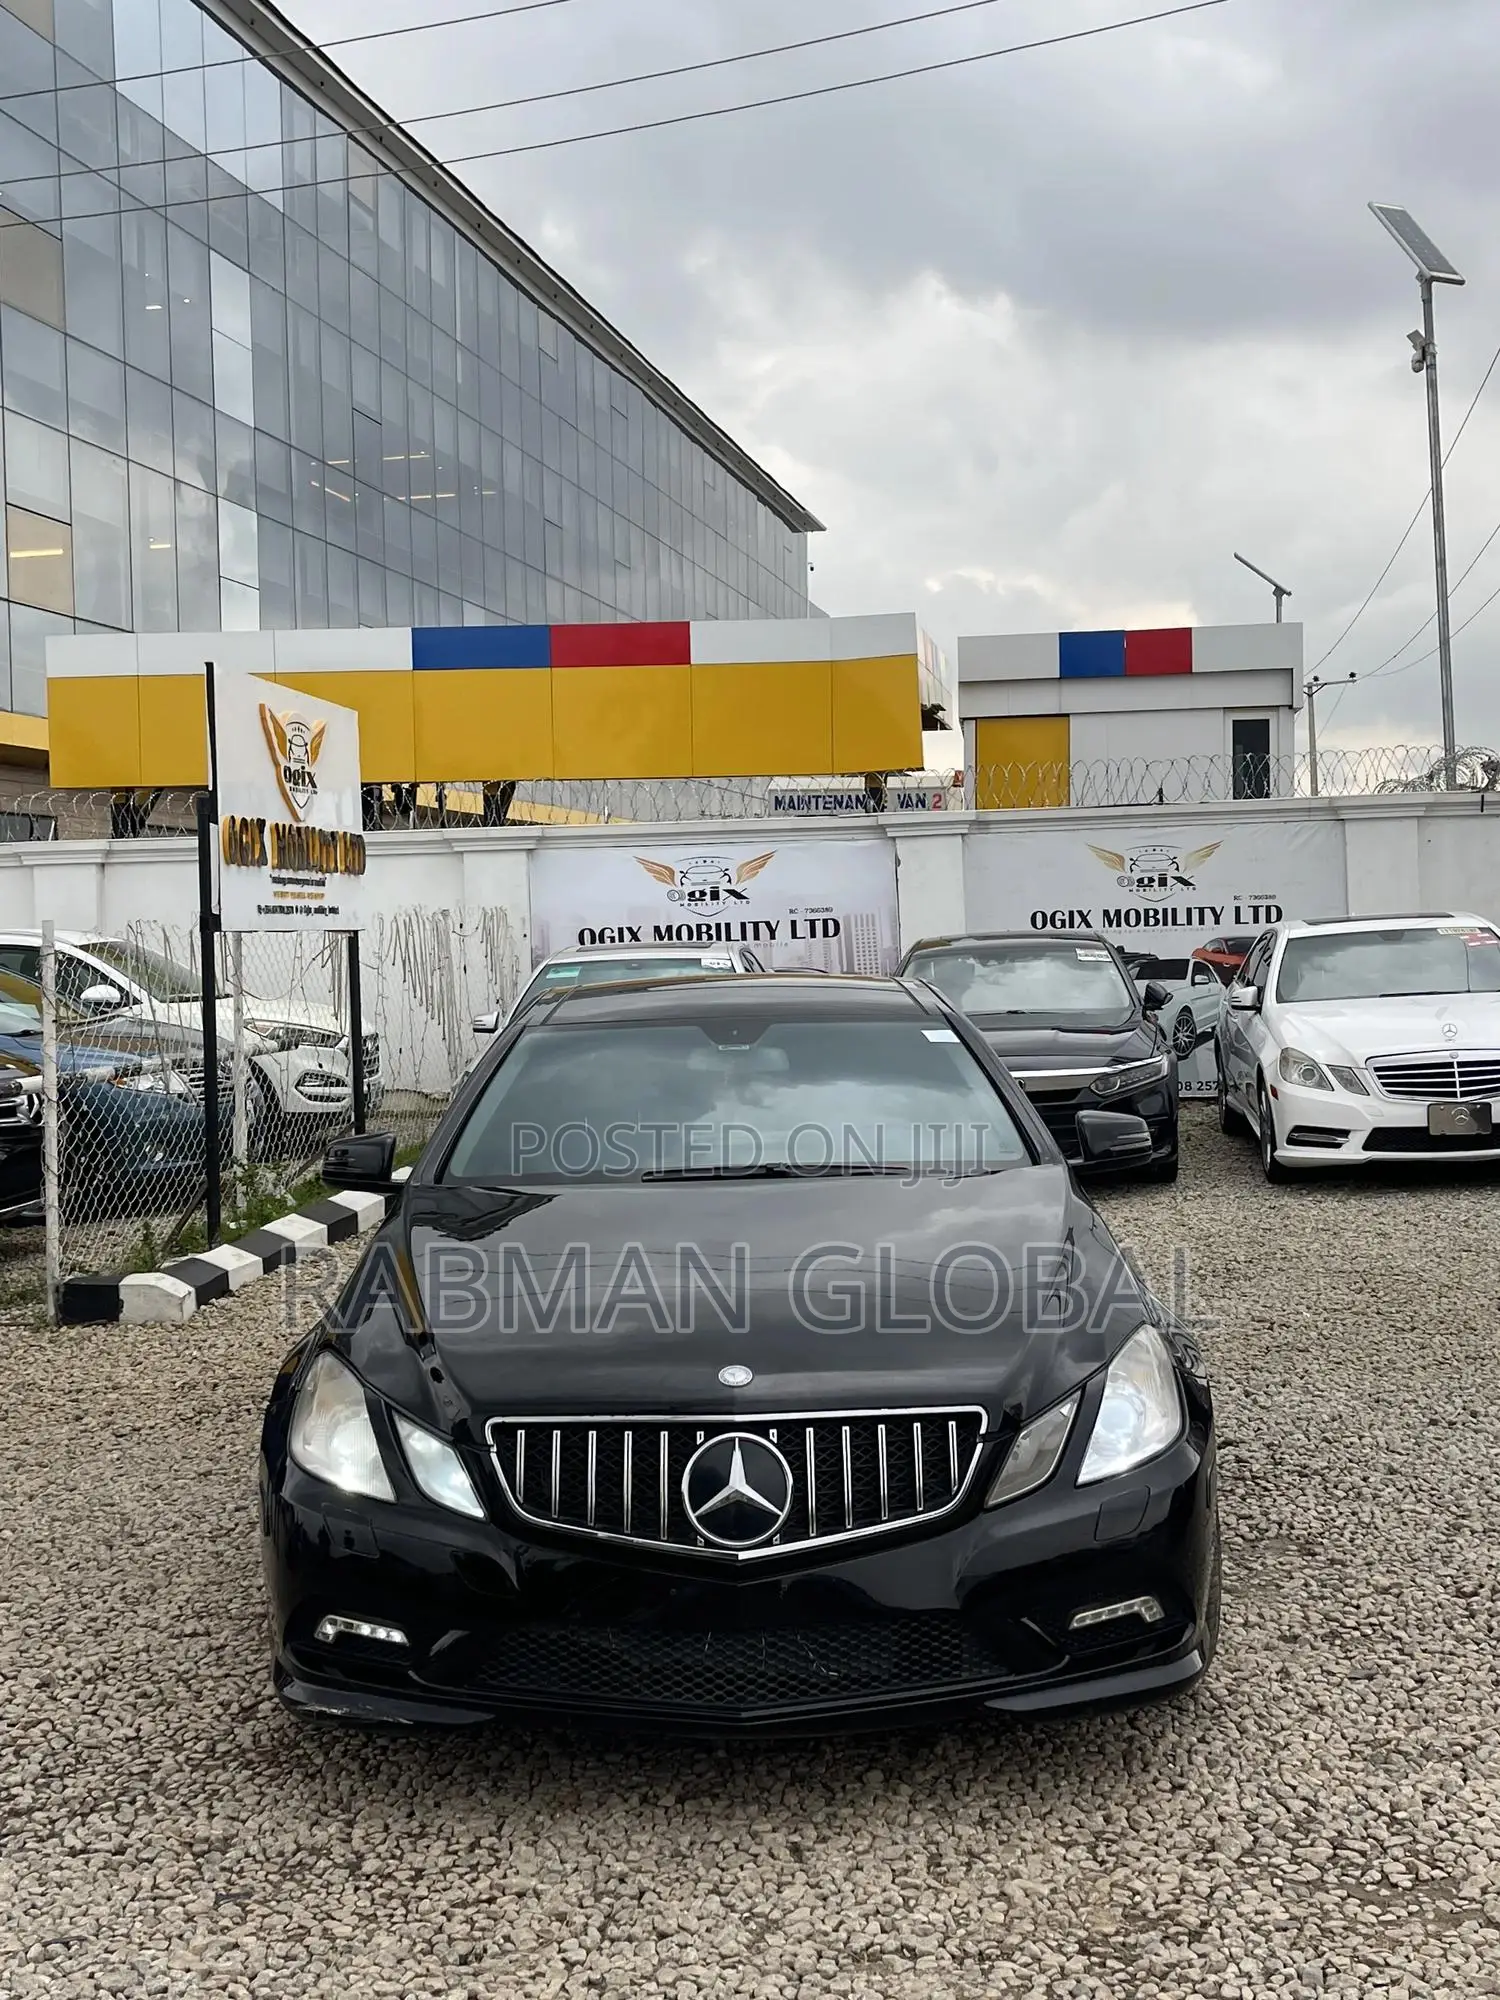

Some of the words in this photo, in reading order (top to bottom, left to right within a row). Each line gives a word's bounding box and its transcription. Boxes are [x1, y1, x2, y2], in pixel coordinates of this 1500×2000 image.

[774, 793, 888, 811] MAINTENAN
[897, 793, 927, 809] VAN
[932, 793, 942, 809] 2
[1030, 909, 1094, 930] OGIX
[1102, 906, 1225, 928] MOBILITY
[1234, 904, 1283, 925] LTD
[578, 925, 642, 946] OGIX
[653, 919, 780, 942] MOBILITY
[790, 917, 841, 940] LTD
